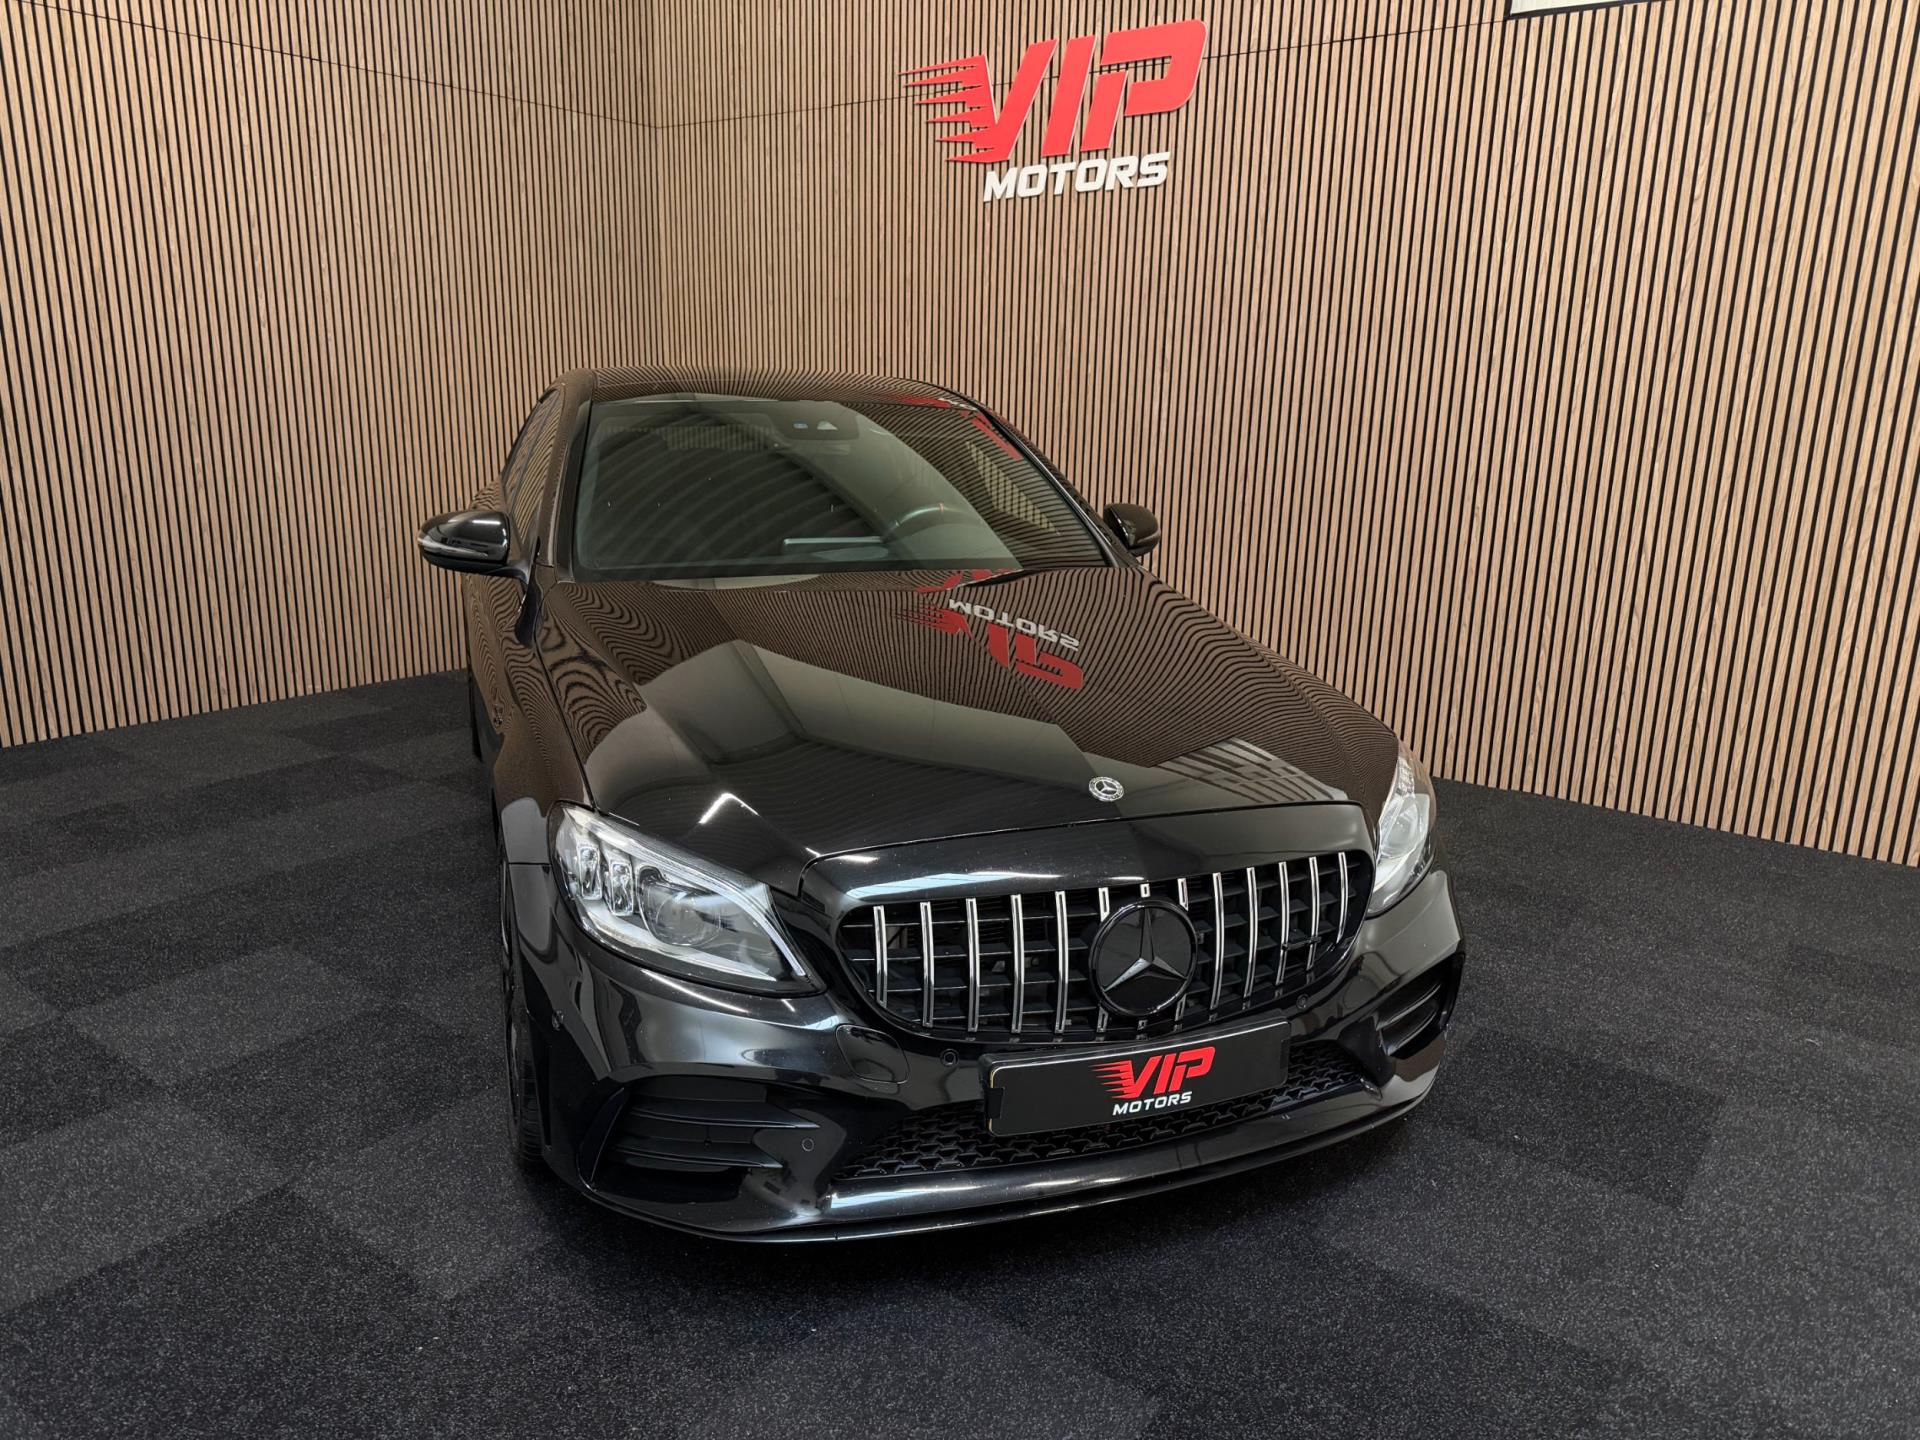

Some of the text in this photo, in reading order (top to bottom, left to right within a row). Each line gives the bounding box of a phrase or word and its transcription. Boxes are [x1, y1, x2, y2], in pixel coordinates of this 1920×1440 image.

[898, 19, 1208, 164] VIP
[983, 151, 1171, 203] MOTORS
[1088, 1045, 1217, 1099] VIP
[1112, 1090, 1193, 1116] MOTORS
